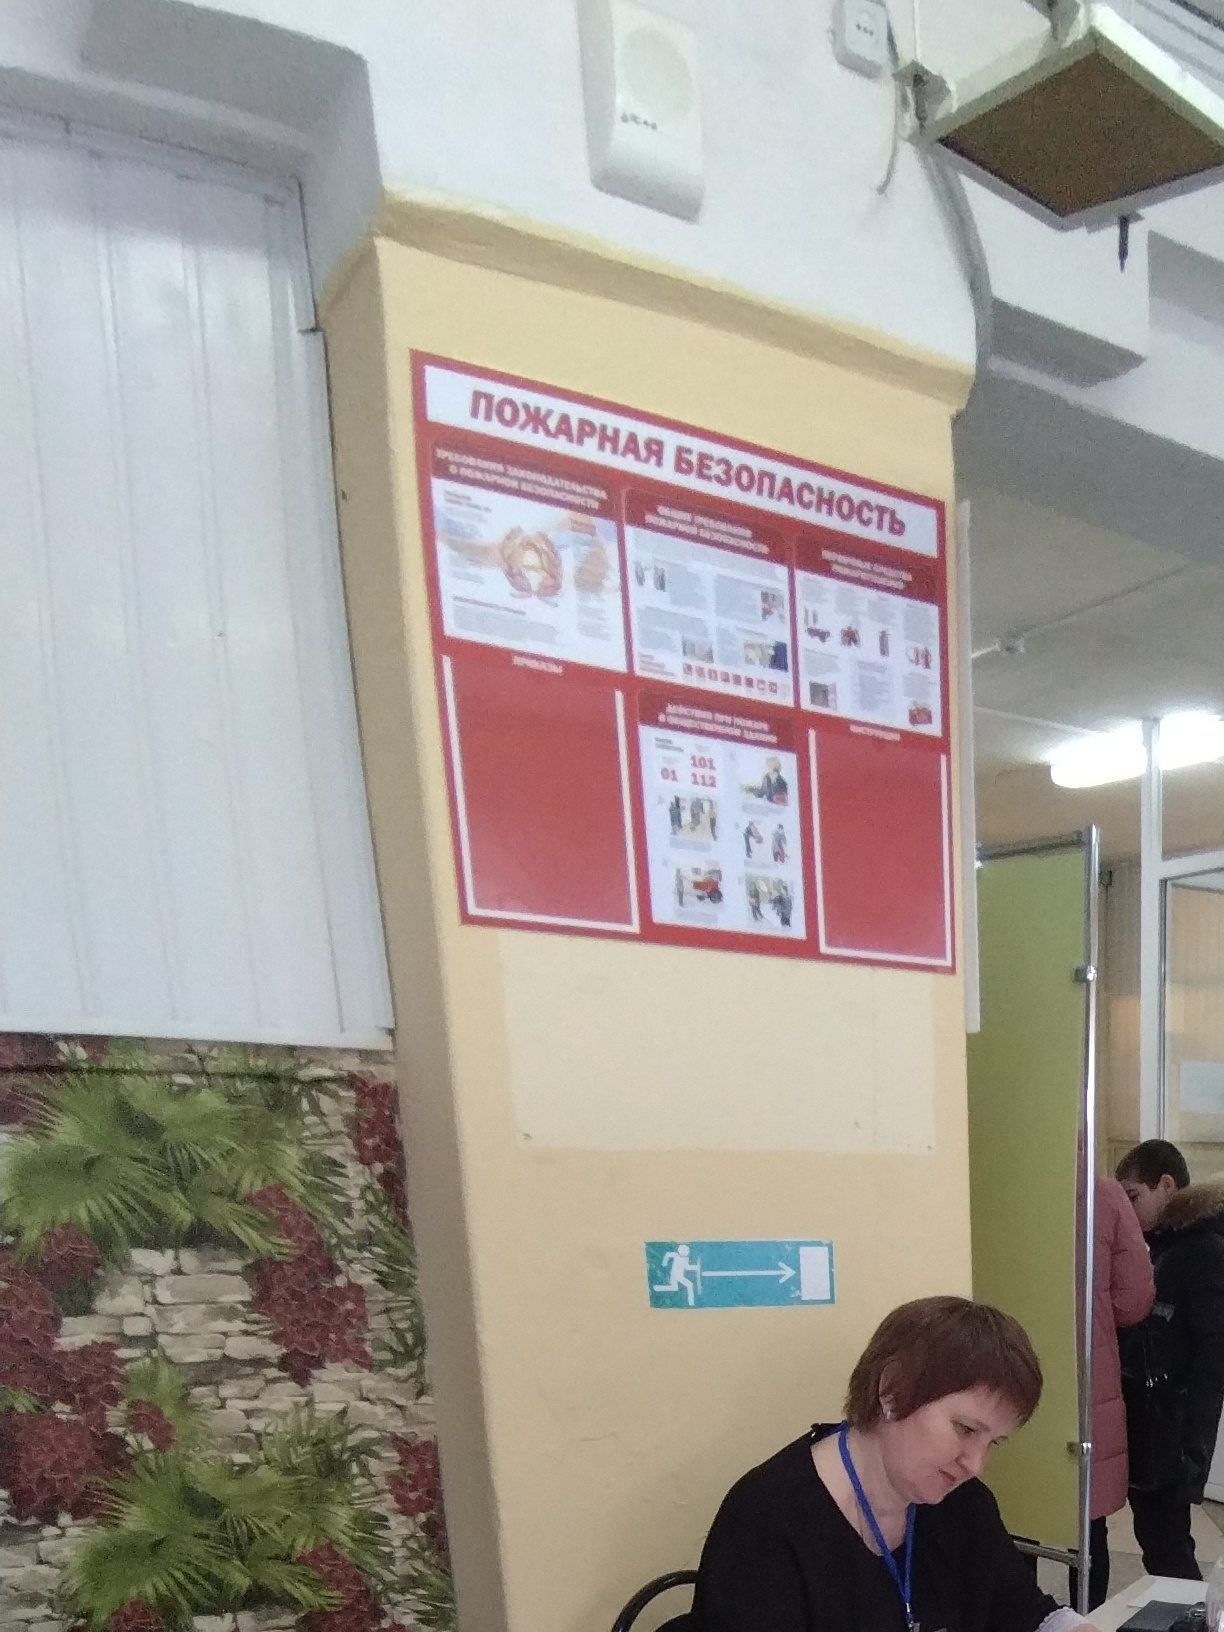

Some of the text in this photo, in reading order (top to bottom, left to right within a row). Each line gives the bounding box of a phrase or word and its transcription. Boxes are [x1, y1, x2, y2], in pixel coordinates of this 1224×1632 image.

[470, 389, 664, 468] ПОЖАРНАЯ
[673, 446, 906, 537] БЕЗОПАСНОСТЬ
[691, 755, 716, 770] 101
[660, 767, 678, 782] 01
[691, 772, 717, 788] 112
